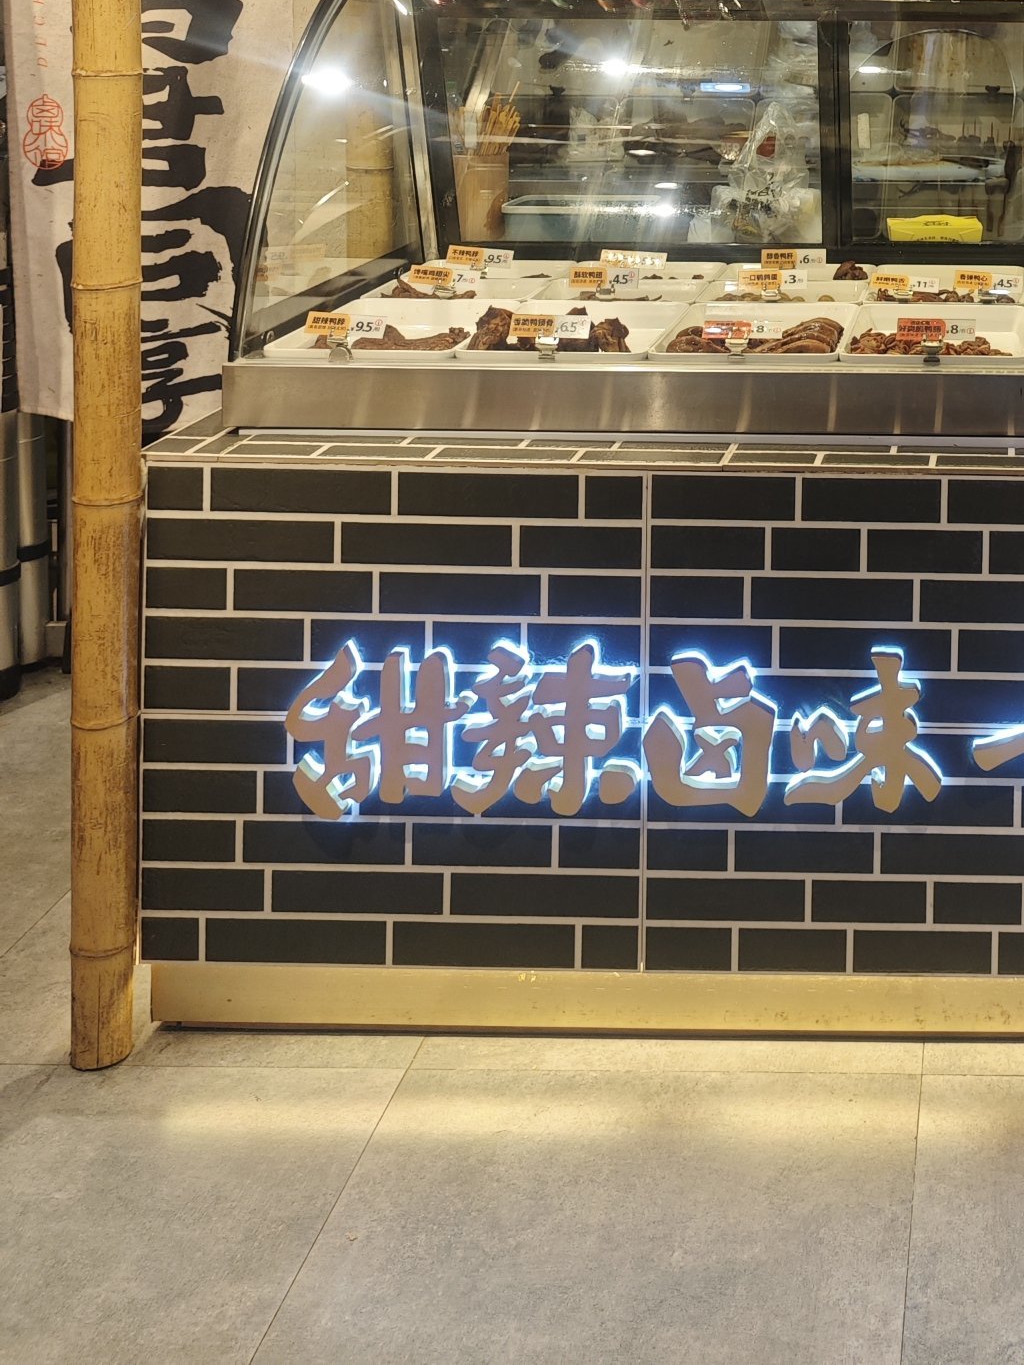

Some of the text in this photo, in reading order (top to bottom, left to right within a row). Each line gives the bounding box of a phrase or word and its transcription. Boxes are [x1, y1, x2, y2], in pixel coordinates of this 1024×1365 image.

[312, 316, 346, 325] 甜辣鸭脖
[285, 638, 943, 819] 甜辣卤味
